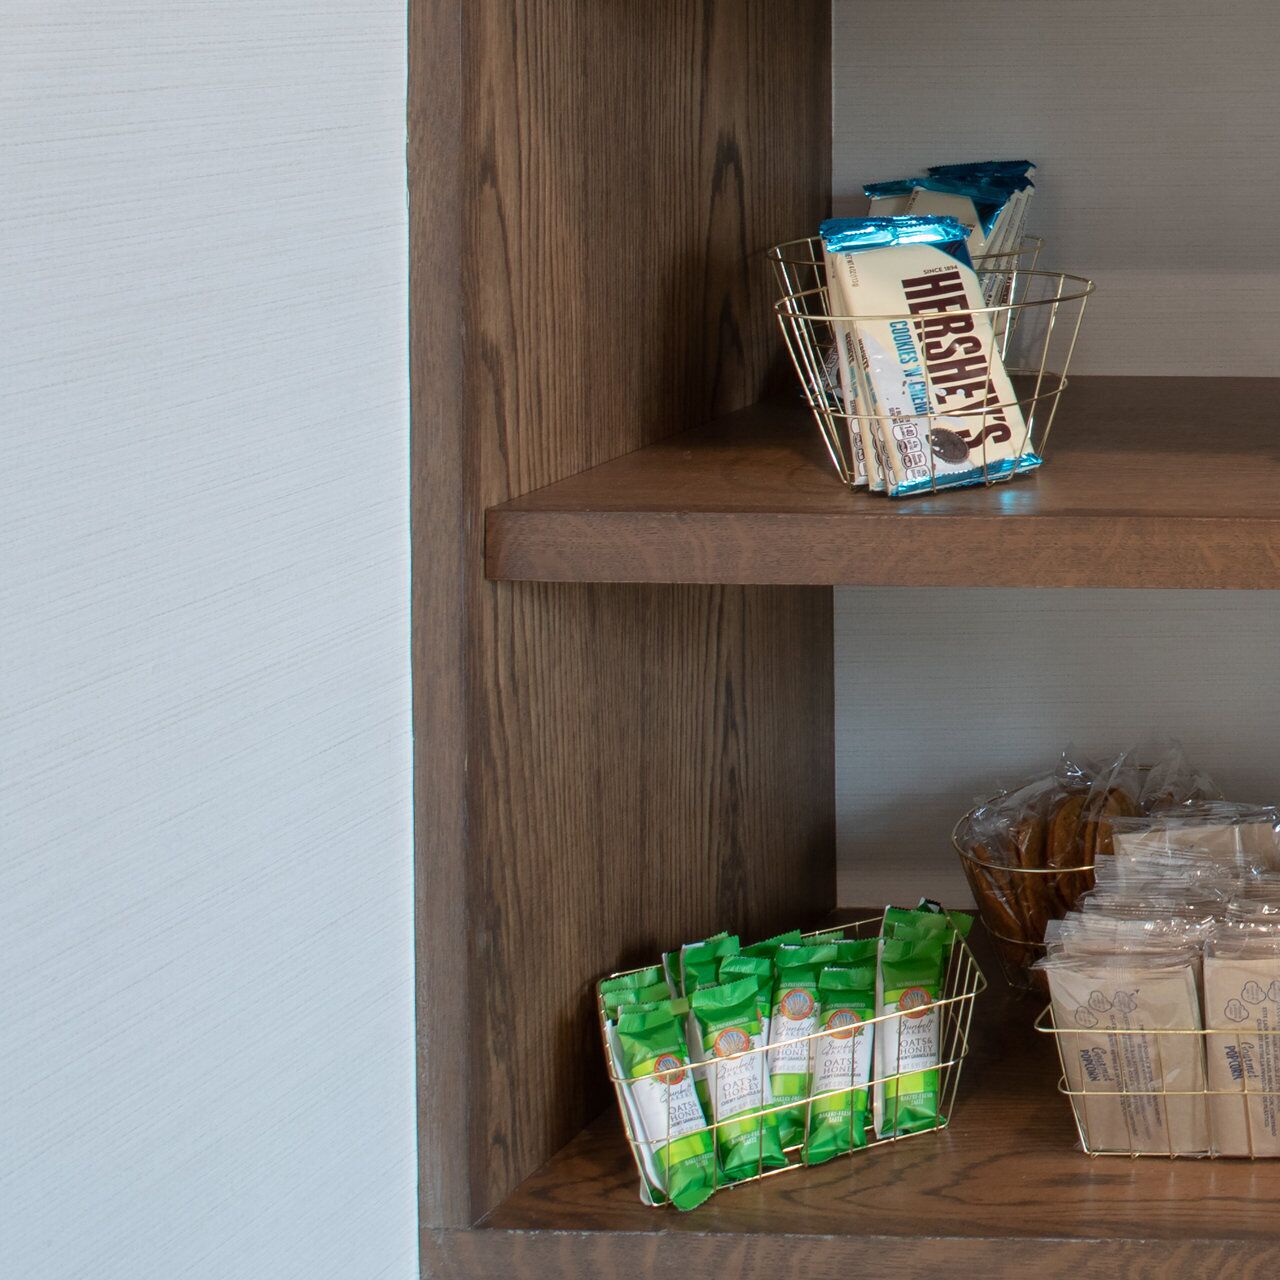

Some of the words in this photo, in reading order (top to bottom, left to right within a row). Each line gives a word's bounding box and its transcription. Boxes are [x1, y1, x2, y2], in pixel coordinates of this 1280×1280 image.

[923, 266, 943, 275] SINCE
[943, 264, 959, 272] 1894
[890, 320, 919, 367] COOKIES
[900, 1045, 933, 1056] HONEY
[1079, 1047, 1101, 1083] POPCORN
[1091, 1045, 1113, 1083] Gourmet
[1223, 1044, 1245, 1082] POPCORN
[1240, 1040, 1256, 1080] Gourmet
[670, 1108, 701, 1123] HONEY
